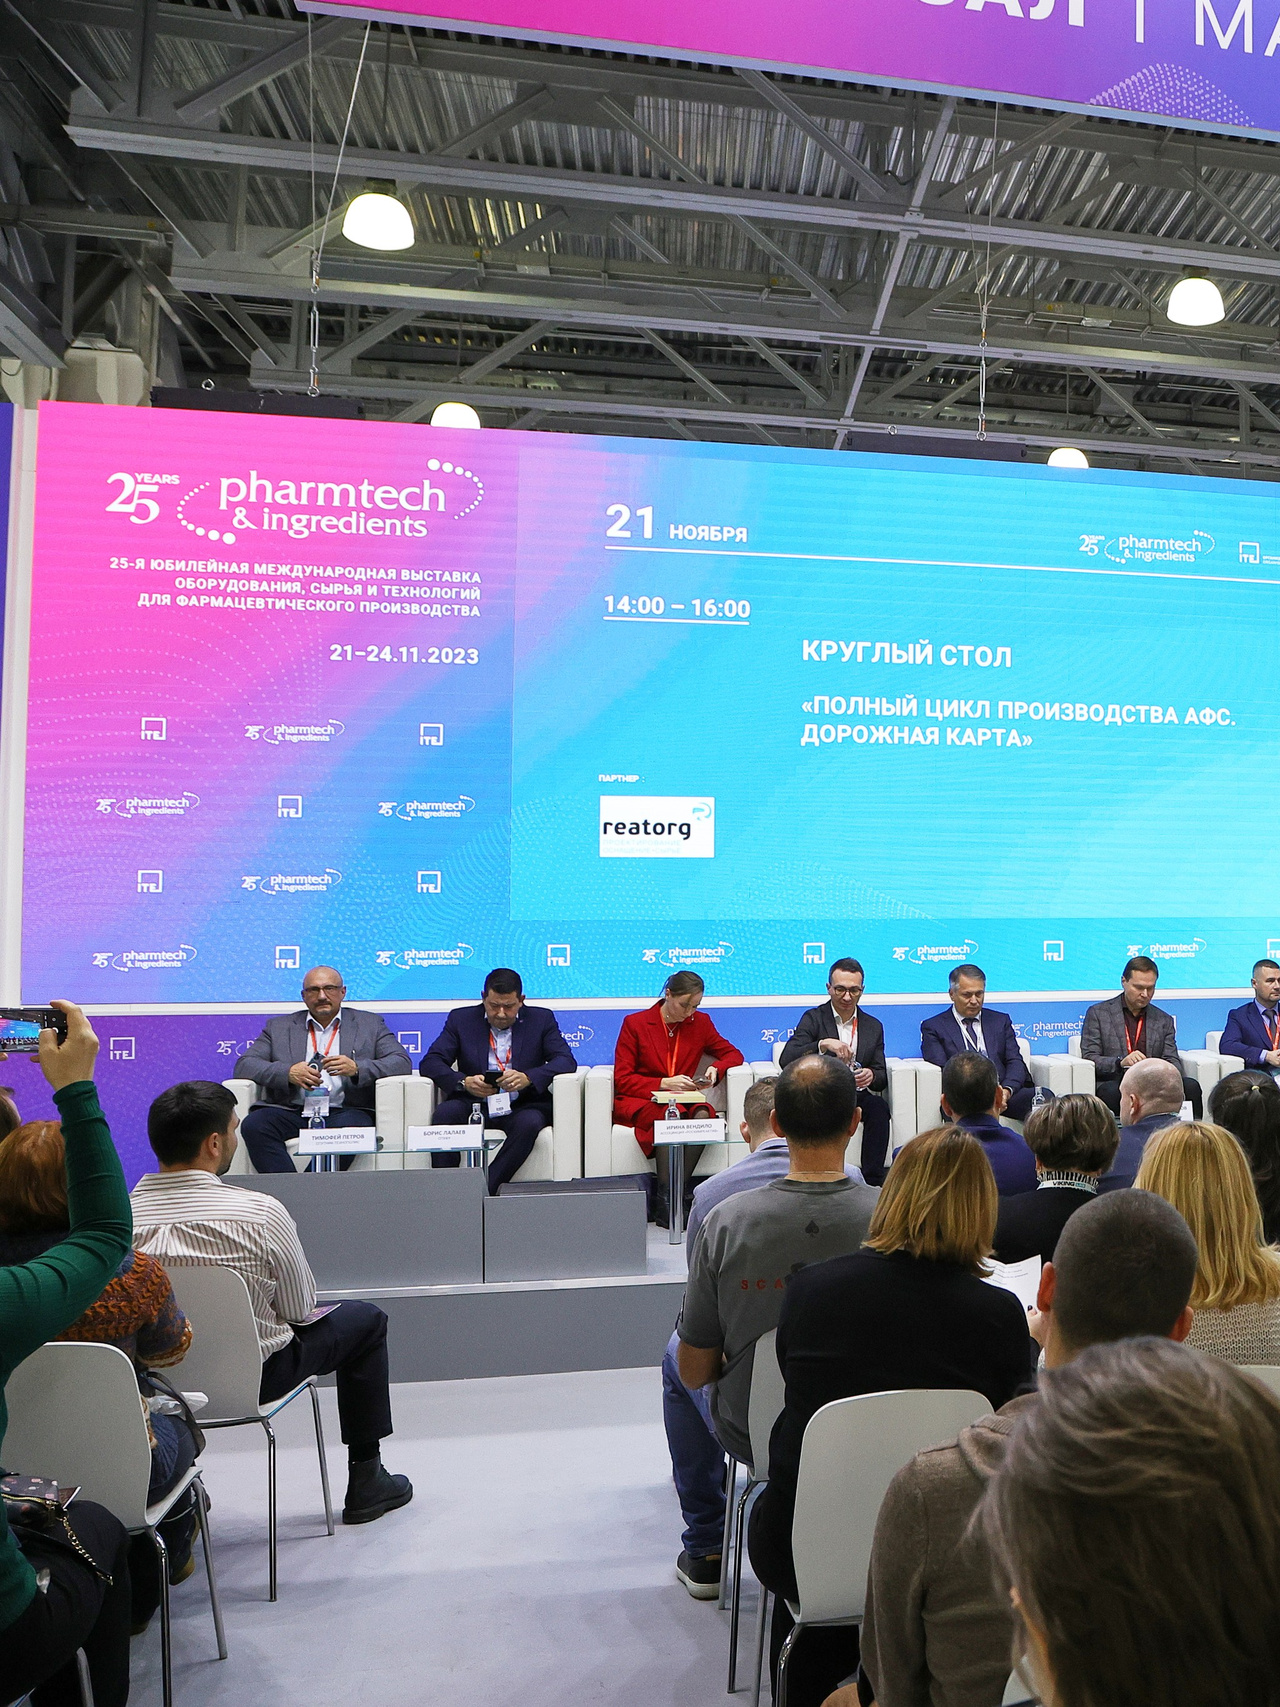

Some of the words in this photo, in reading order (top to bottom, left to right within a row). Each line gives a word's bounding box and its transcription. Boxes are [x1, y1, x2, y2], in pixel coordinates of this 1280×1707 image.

[134, 473, 180, 485] YEARS
[105, 472, 160, 524] 25
[218, 470, 446, 513] pharmtech
[232, 506, 258, 530] &
[262, 507, 428, 539] ingredients
[605, 504, 655, 539] 21
[669, 523, 748, 543] НОЯБРЯ
[1079, 534, 1099, 556] 25
[1118, 534, 1202, 552] pharmtech
[1135, 549, 1195, 563] ingredients
[109, 557, 146, 570] 25-Я
[150, 557, 249, 575] ЮБИЛЕЙНАЯ
[254, 562, 397, 581] МЕЖДУНАРОДНАЯ
[401, 569, 482, 584] ВЫСТАВКА
[175, 577, 306, 596] ОБОРУДОВАНИЯ,
[310, 582, 363, 596] СЫРЬЯ
[367, 584, 379, 597] И
[382, 583, 481, 601] ТЕХНОЛОГИЙ
[137, 593, 172, 608] ДЛЯ
[175, 593, 356, 614] ФАРМАЦЕВТИЧЕСКОГО
[360, 601, 481, 618] ПРОИЗВОДСТВА
[604, 595, 665, 615] 14:00
[691, 598, 751, 618] 16:00
[802, 639, 933, 666] КРУГЛЫЙ
[940, 645, 1012, 668] СТОЛ
[801, 694, 918, 718] «ПОЛНЫЙ
[925, 698, 991, 722] ЦИКЛ
[997, 702, 1179, 727] ПРОИЗВОДСТВА
[1184, 705, 1236, 727] АФС.
[273, 723, 334, 736] pharmtech
[800, 724, 939, 747] ДОРОЖНАЯ
[946, 727, 1033, 748] КАРТА»
[126, 797, 189, 809] pharmtech
[406, 800, 465, 812] pharmtech
[603, 819, 691, 840] reatorg
[270, 873, 332, 886] pharmtech
[123, 950, 187, 962] pharmtech
[404, 948, 464, 960] pharmtech
[669, 946, 725, 958] pharmtech
[917, 945, 970, 956] pharmtech
[1150, 943, 1199, 954] pharmtech
